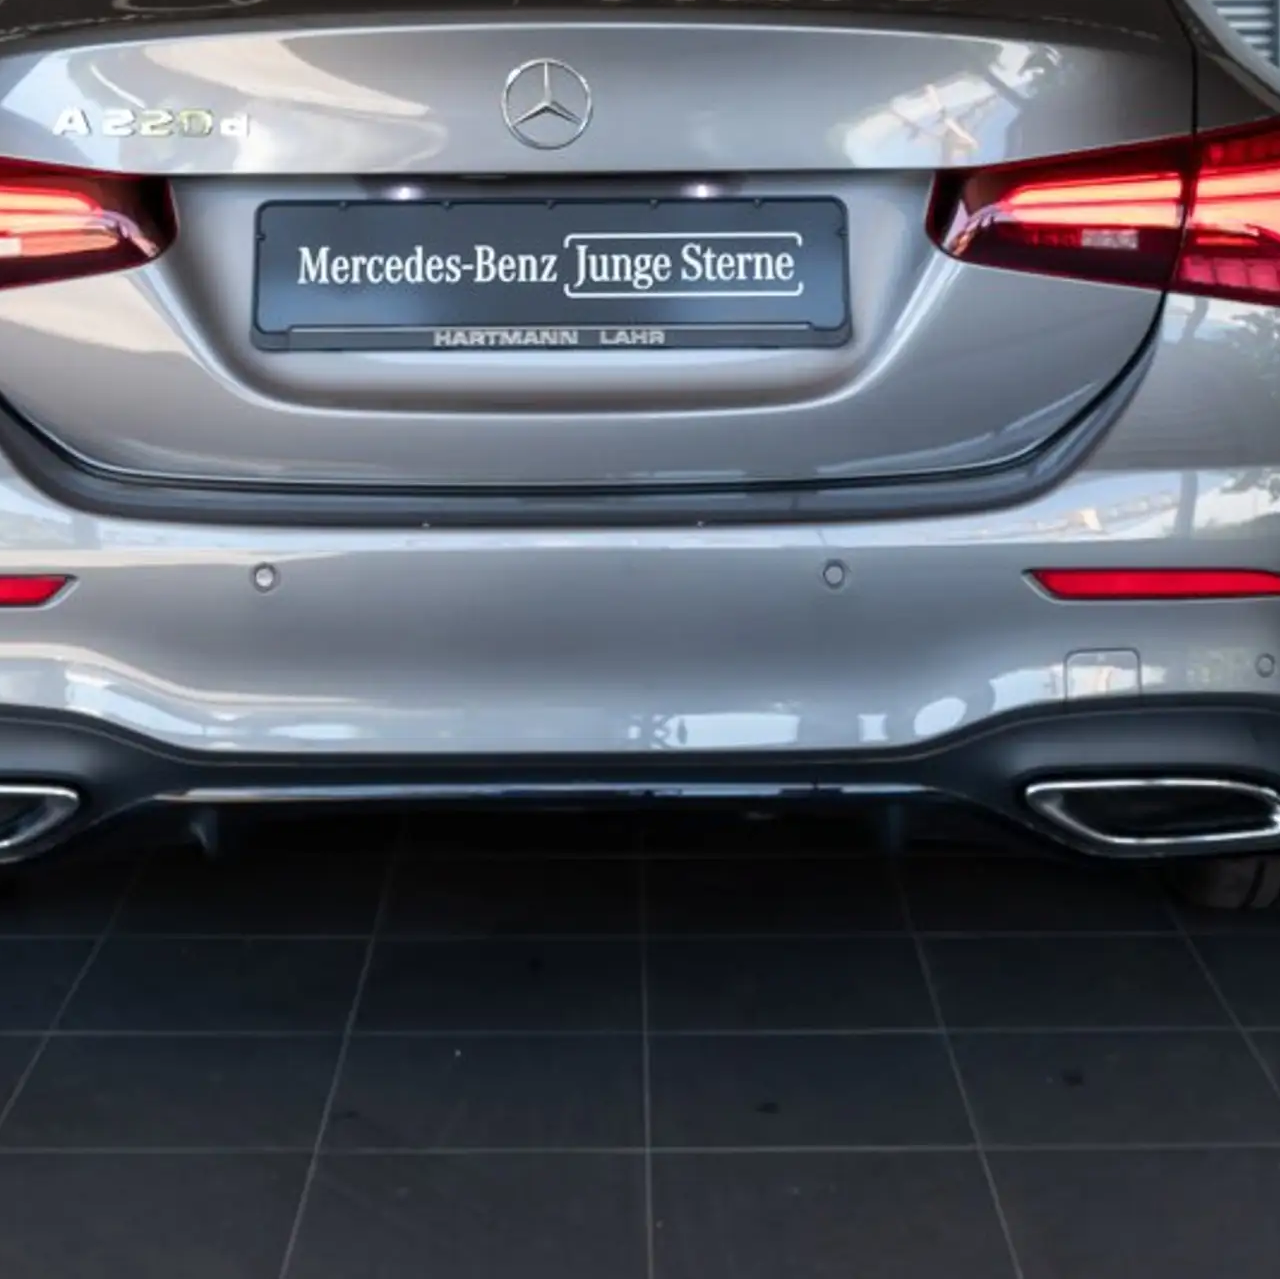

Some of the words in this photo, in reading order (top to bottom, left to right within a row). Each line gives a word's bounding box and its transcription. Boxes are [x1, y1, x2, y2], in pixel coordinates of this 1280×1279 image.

[297, 244, 558, 285] Mercedes-Benz
[573, 243, 672, 290] Junge
[680, 241, 795, 283] Sterne
[433, 329, 579, 347] HARTMANN
[599, 329, 666, 346] LAHR
